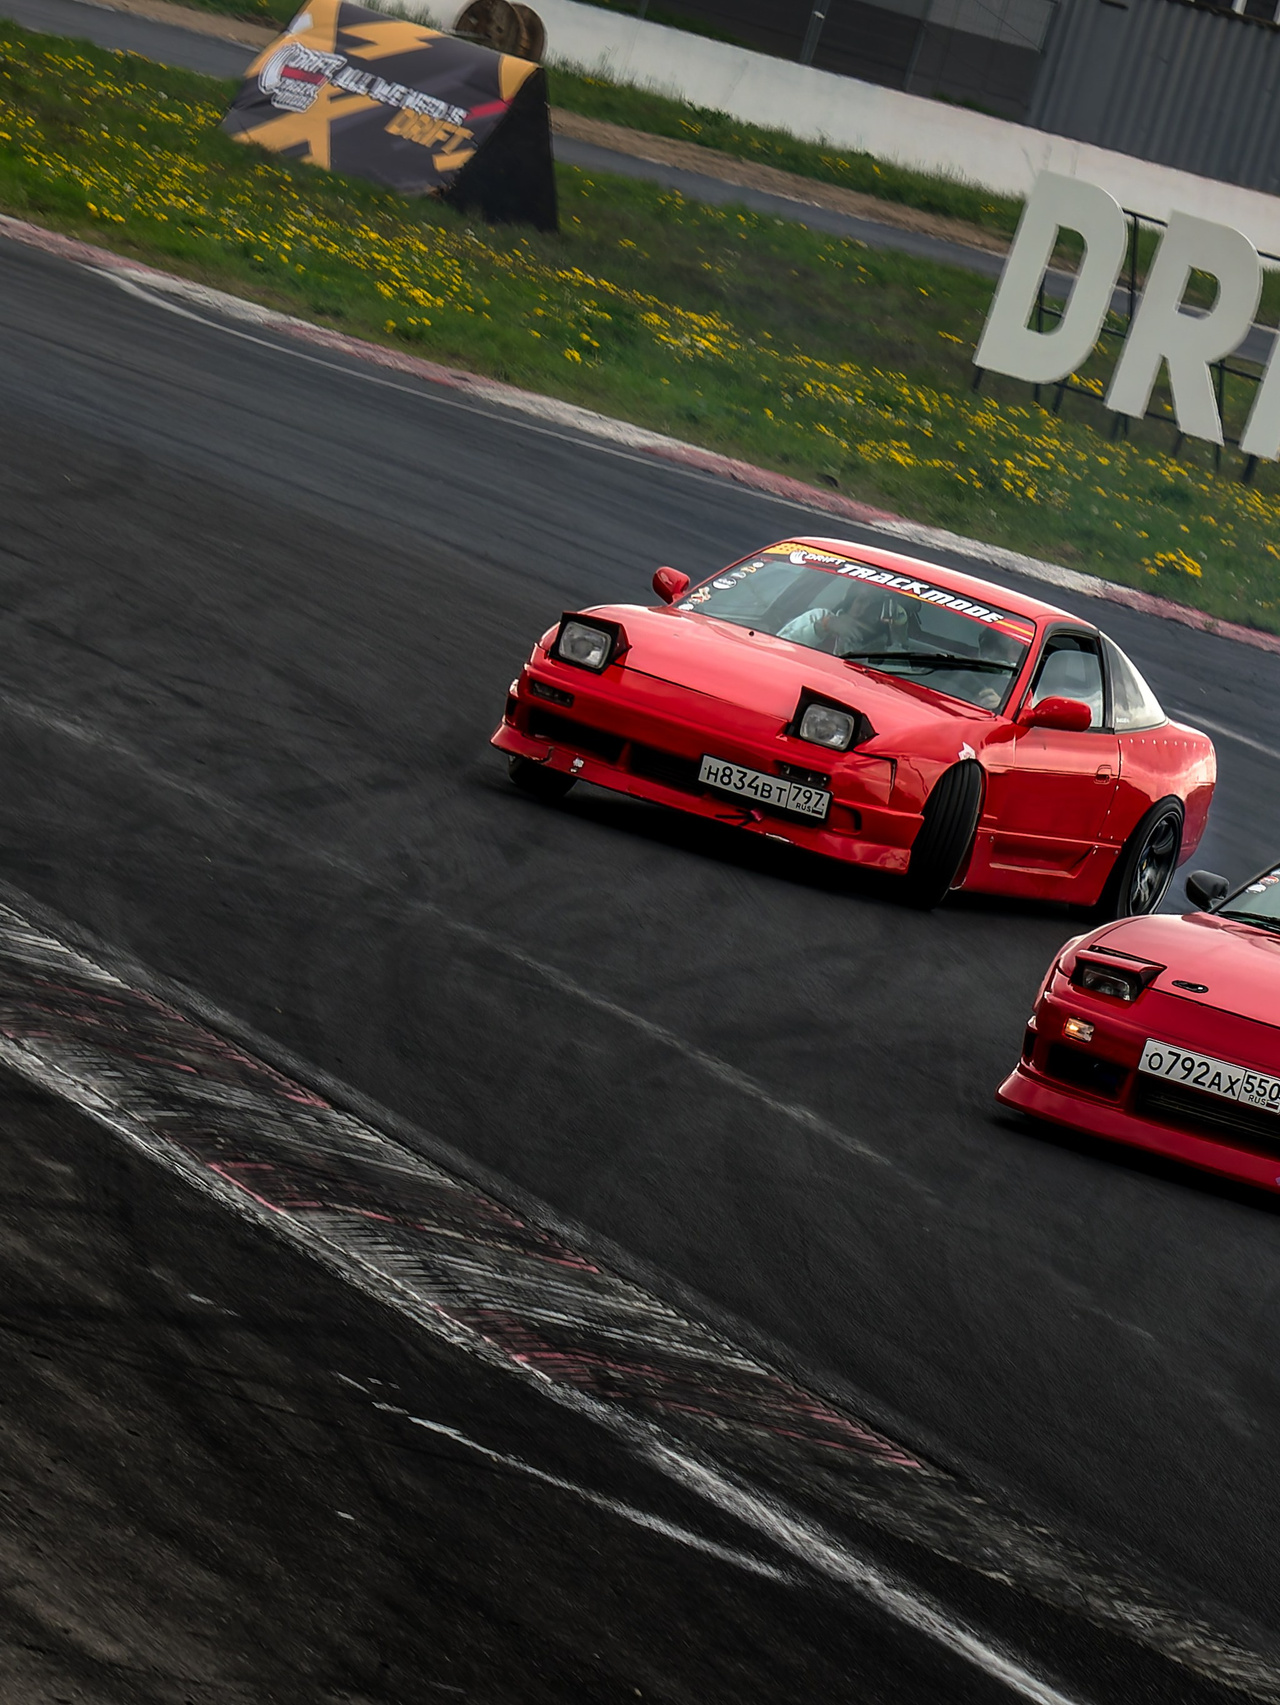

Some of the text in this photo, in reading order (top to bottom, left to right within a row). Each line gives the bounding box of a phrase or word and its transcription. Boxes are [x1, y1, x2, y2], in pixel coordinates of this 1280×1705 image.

[384, 107, 475, 155] DRIFT
[804, 552, 846, 566] DRIFT
[792, 785, 825, 809] 797
[796, 802, 812, 813] RUS
[1248, 1094, 1267, 1106] RUS
